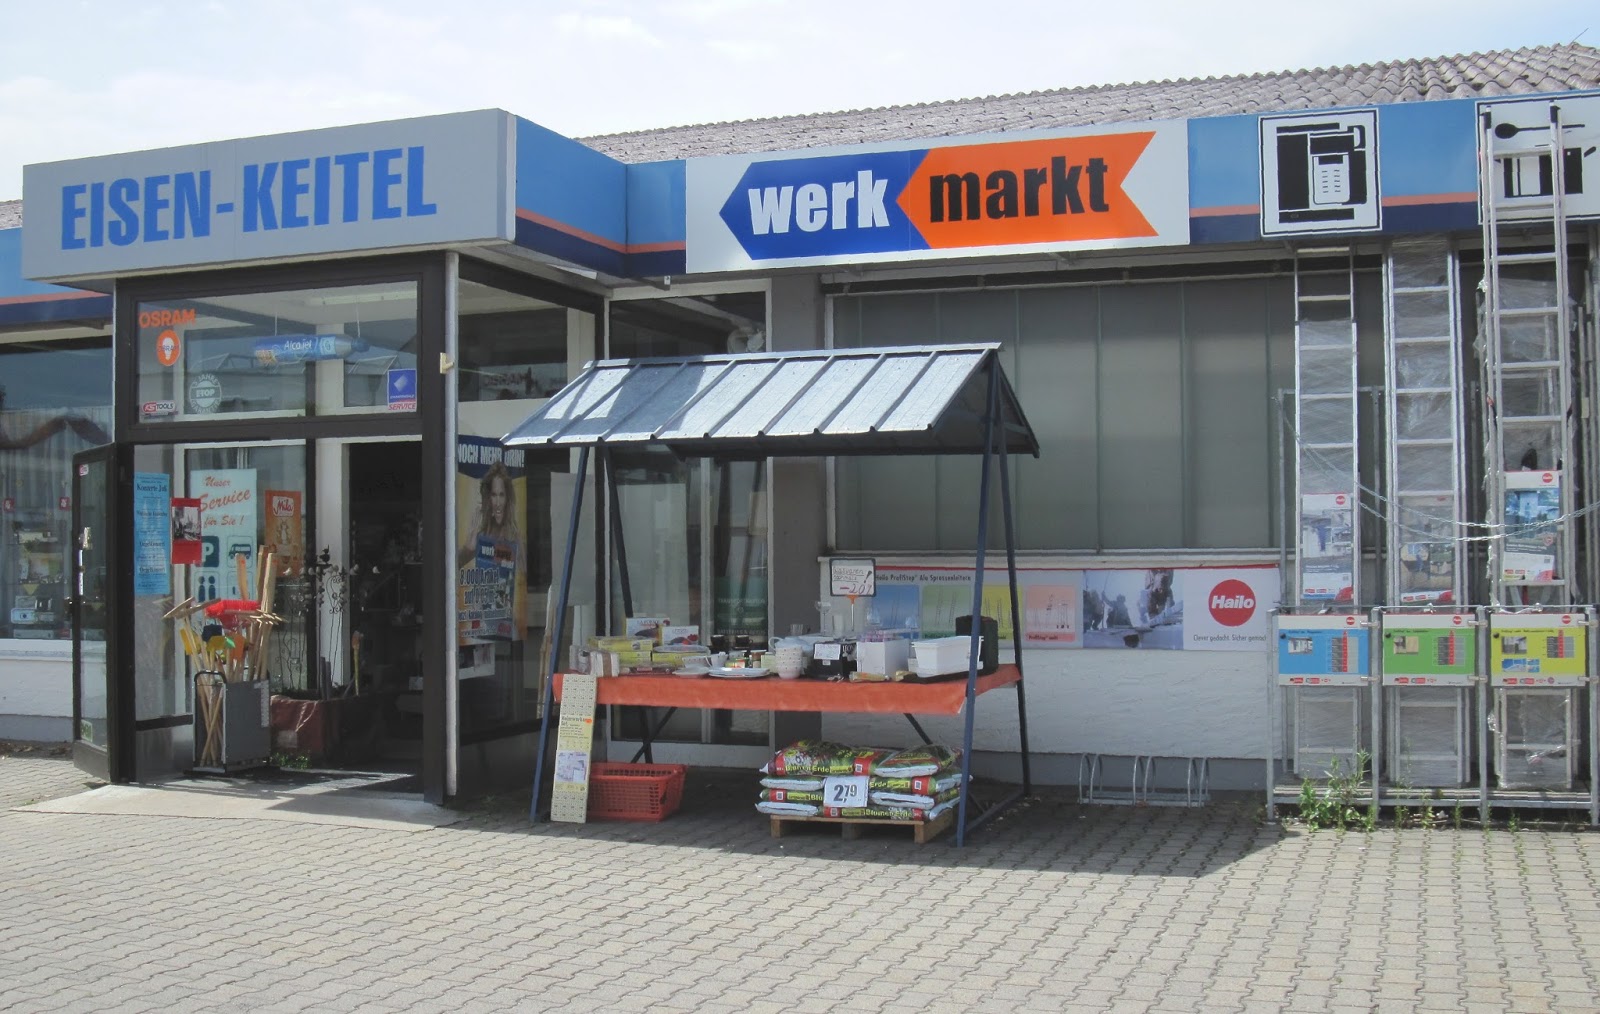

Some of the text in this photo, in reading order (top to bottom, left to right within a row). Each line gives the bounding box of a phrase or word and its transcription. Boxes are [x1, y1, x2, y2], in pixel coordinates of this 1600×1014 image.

[929, 156, 1110, 223] markt
[61, 146, 437, 250] EISEN-KEITEL
[748, 170, 889, 235] werk
[138, 308, 196, 328] OSRAM
[389, 403, 416, 411] SERVICE
[205, 476, 231, 487] Unser
[197, 490, 251, 512] Service
[205, 517, 217, 529] für
[221, 515, 236, 526] Sie
[1212, 595, 1255, 609] Hailo
[1231, 634, 1247, 642] Sicher
[812, 765, 830, 773] Erde
[833, 784, 858, 803] 2,79
[865, 809, 894, 818] Blumen
[895, 809, 912, 818] Erde
